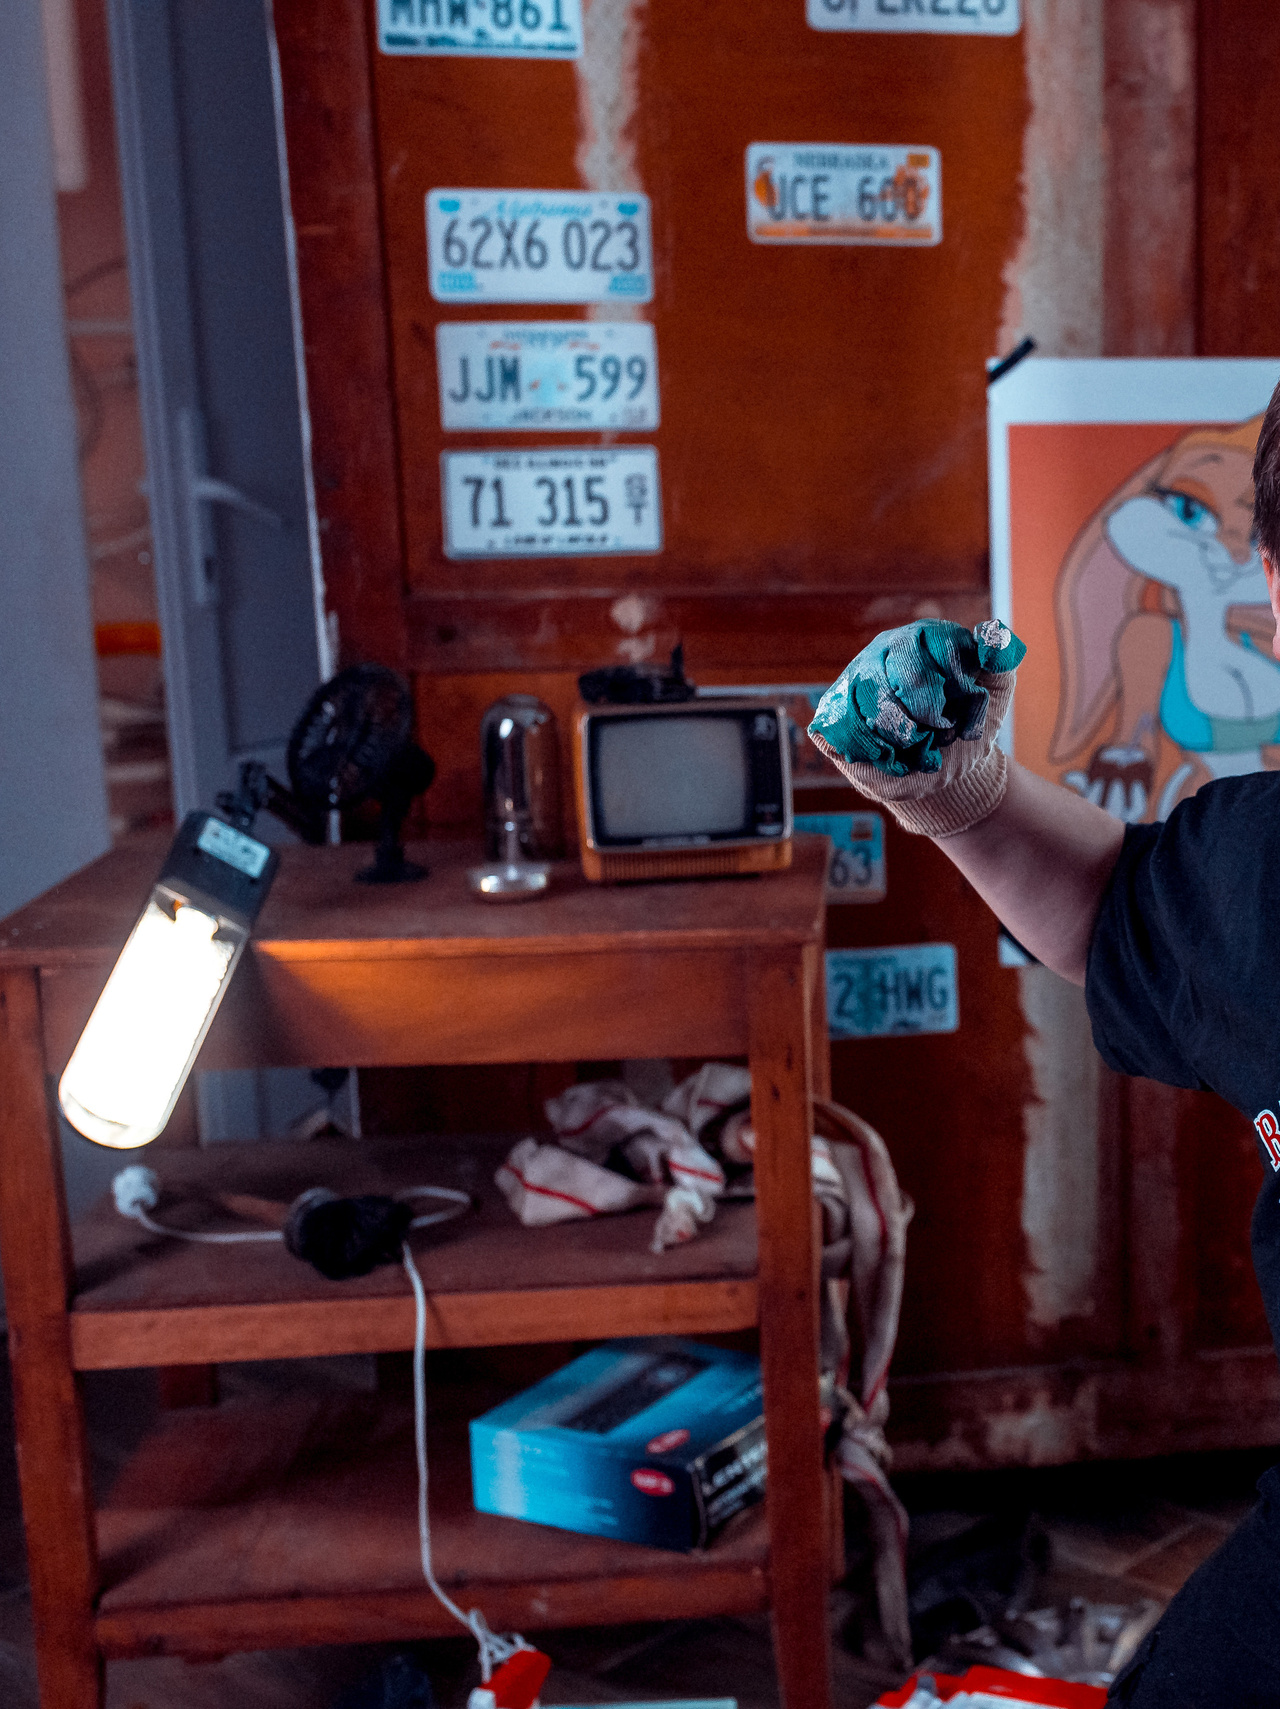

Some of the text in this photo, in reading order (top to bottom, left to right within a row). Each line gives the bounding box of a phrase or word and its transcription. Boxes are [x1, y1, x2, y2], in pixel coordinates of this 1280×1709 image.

[442, 216, 639, 272] 62X6 023
[449, 354, 648, 403] JJM 599
[462, 475, 512, 529] 71
[534, 474, 610, 528] 315
